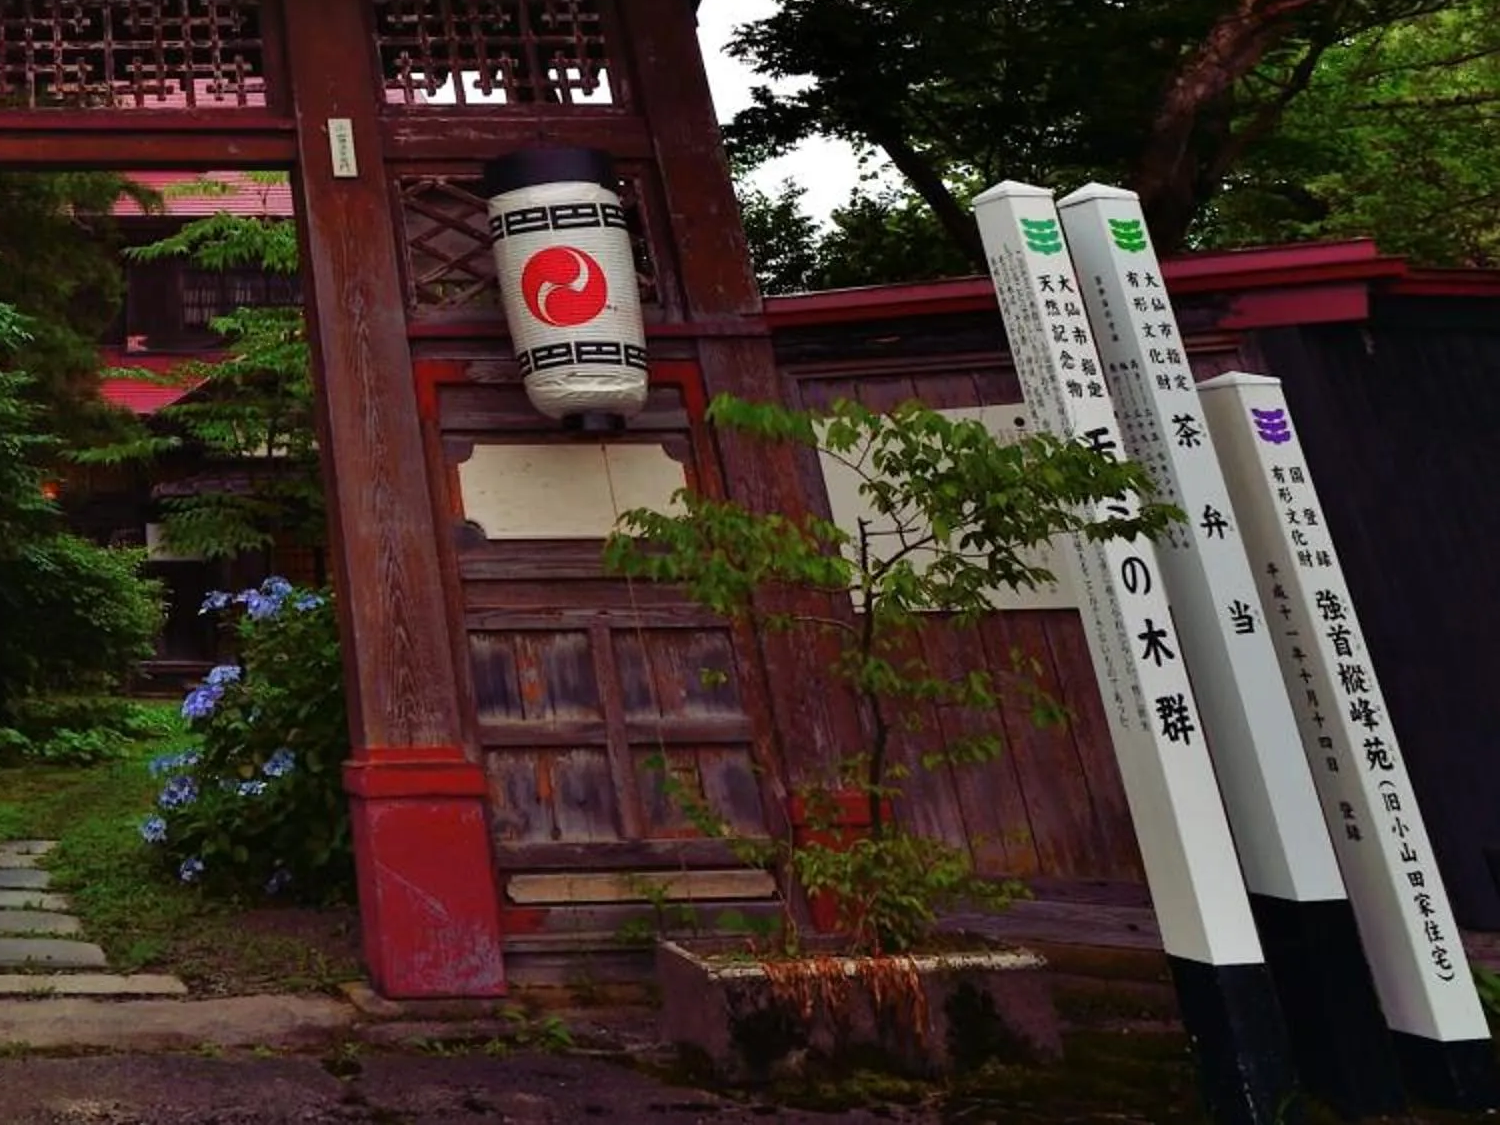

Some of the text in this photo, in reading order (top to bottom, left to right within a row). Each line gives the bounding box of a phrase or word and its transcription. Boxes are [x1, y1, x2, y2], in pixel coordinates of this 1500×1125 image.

[1037, 274, 1084, 399] 天然記念物
[1058, 274, 1104, 399] 大仙市指定
[1126, 271, 1171, 391] 有形文化財
[1144, 272, 1191, 392] 大仙市指定
[1271, 465, 1314, 568] 有形文化財
